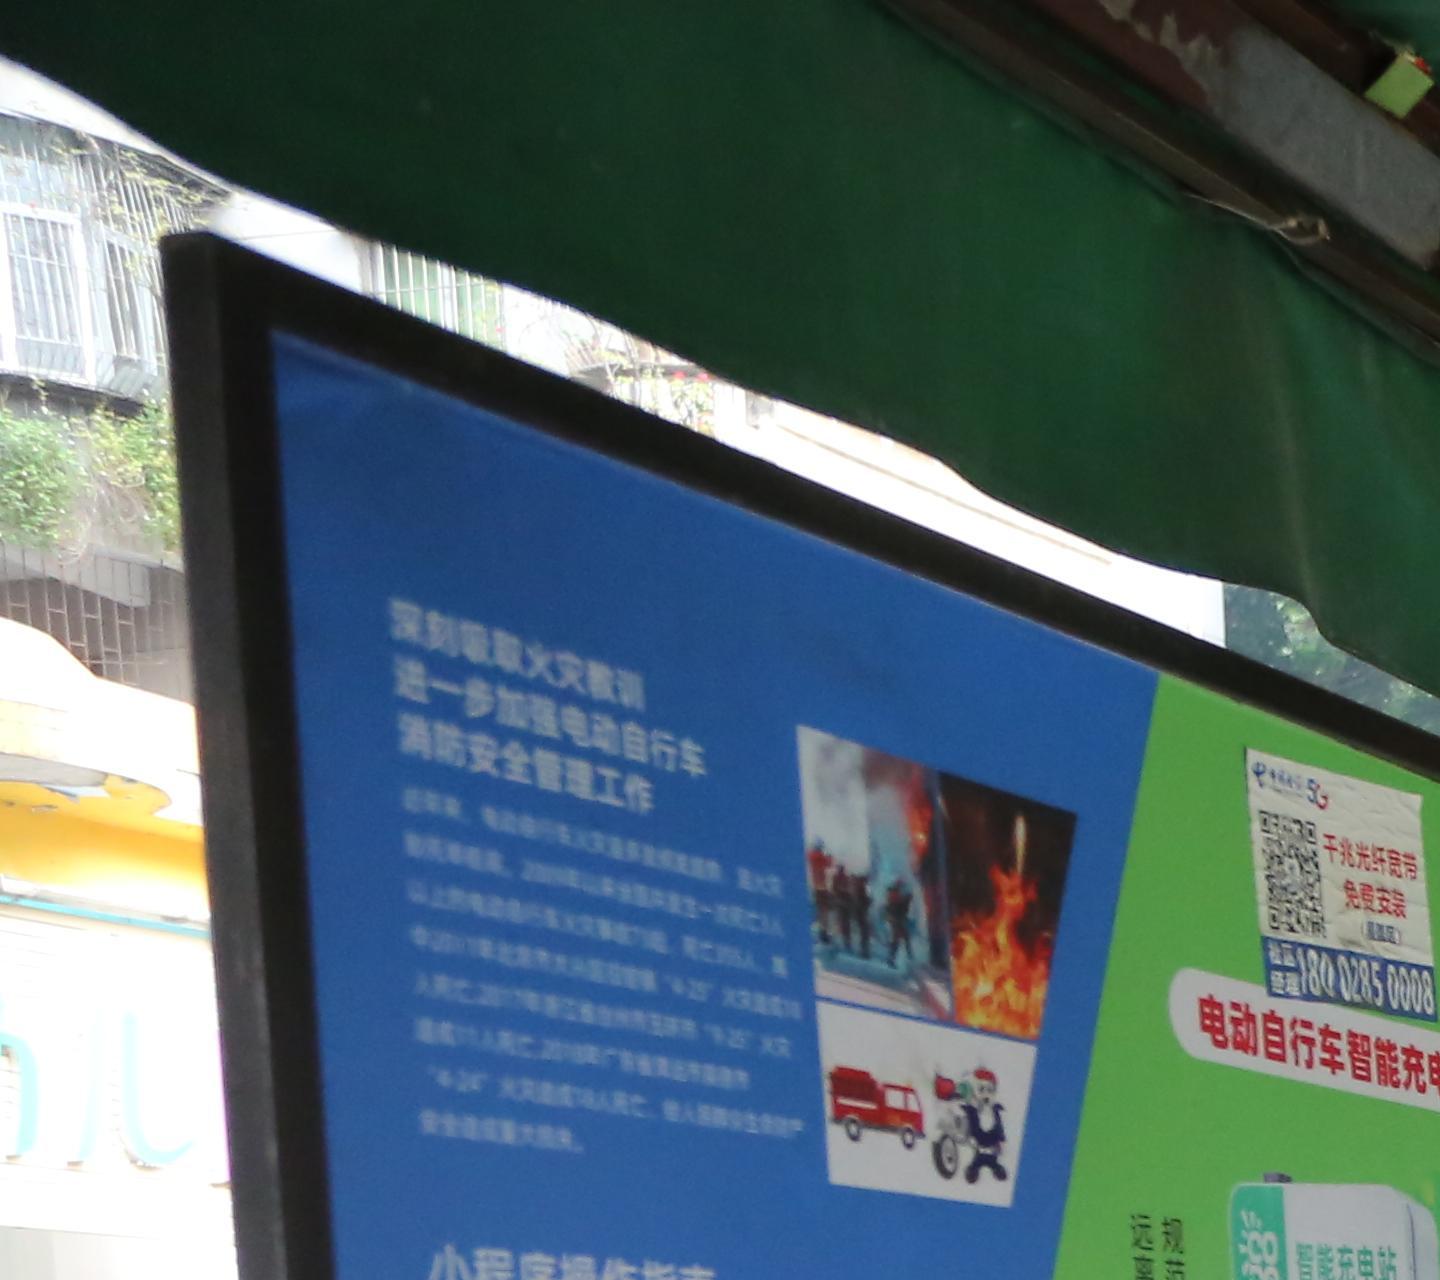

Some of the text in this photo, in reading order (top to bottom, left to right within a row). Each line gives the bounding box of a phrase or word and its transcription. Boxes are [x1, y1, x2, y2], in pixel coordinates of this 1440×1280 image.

[1323, 833, 1418, 880] 千兆光纤宽带
[1344, 880, 1406, 918] 免费安装
